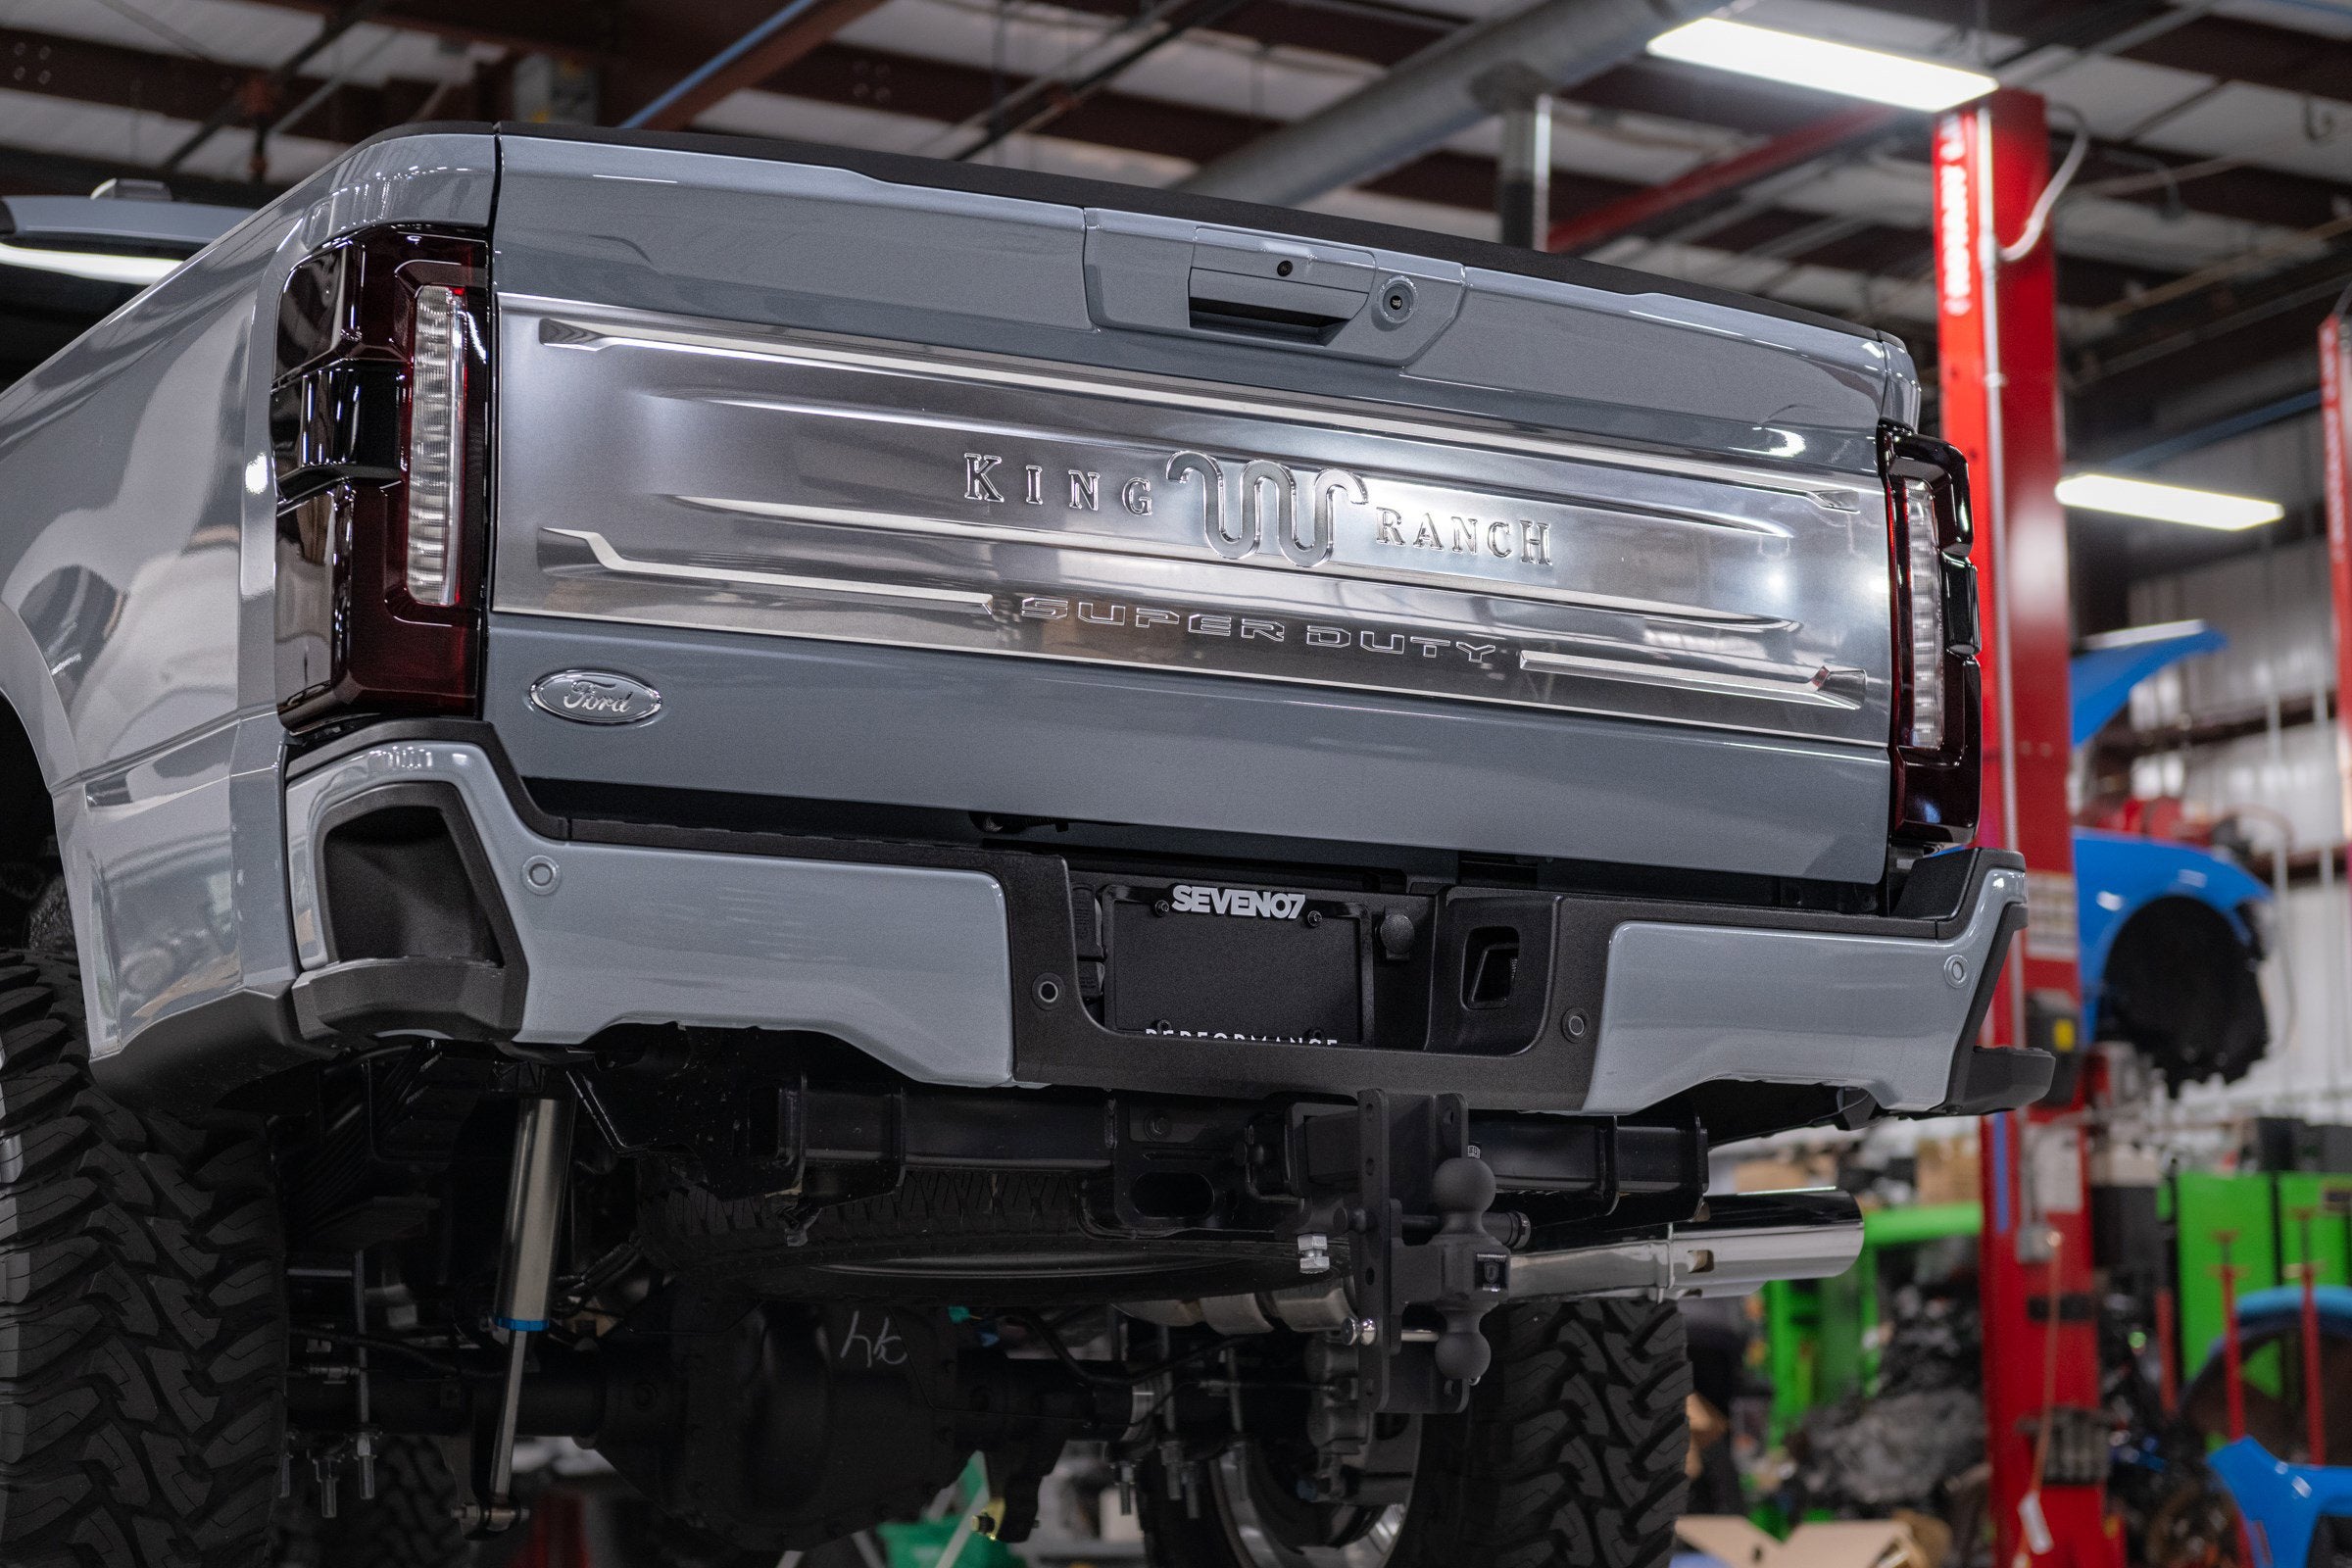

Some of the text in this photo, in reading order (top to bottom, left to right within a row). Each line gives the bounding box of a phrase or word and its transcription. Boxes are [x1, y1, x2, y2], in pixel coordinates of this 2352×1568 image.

[964, 453, 1553, 565] KING RANCH
[1021, 597, 1496, 663] SUPER DUTY
[564, 680, 633, 712] Ford
